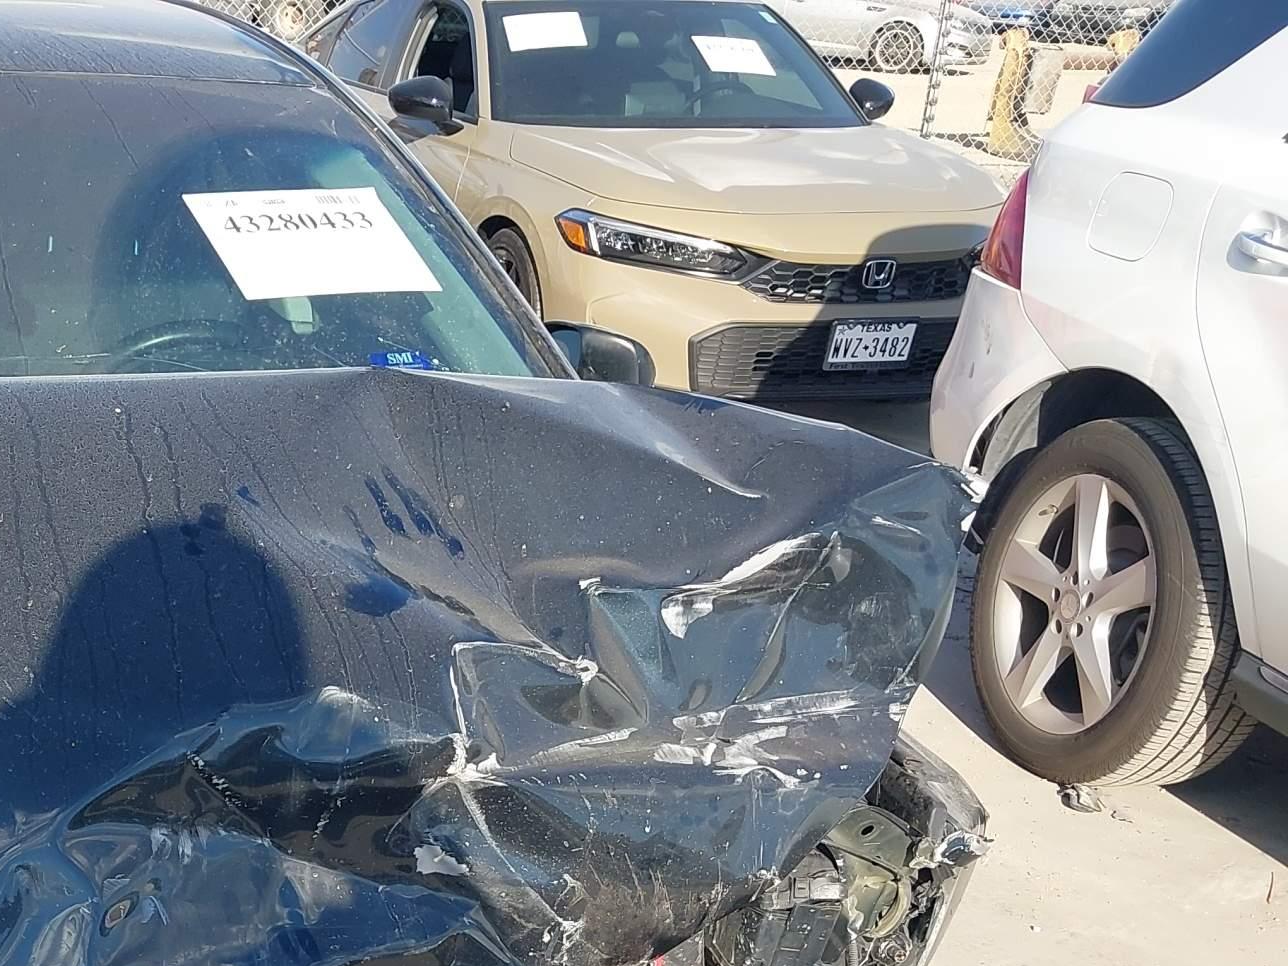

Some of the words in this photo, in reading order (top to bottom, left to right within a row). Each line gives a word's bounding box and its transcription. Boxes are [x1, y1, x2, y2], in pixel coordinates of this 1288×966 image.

[224, 211, 374, 233] 43280433
[860, 322, 893, 333] TEXAS
[386, 351, 414, 365] SMI
